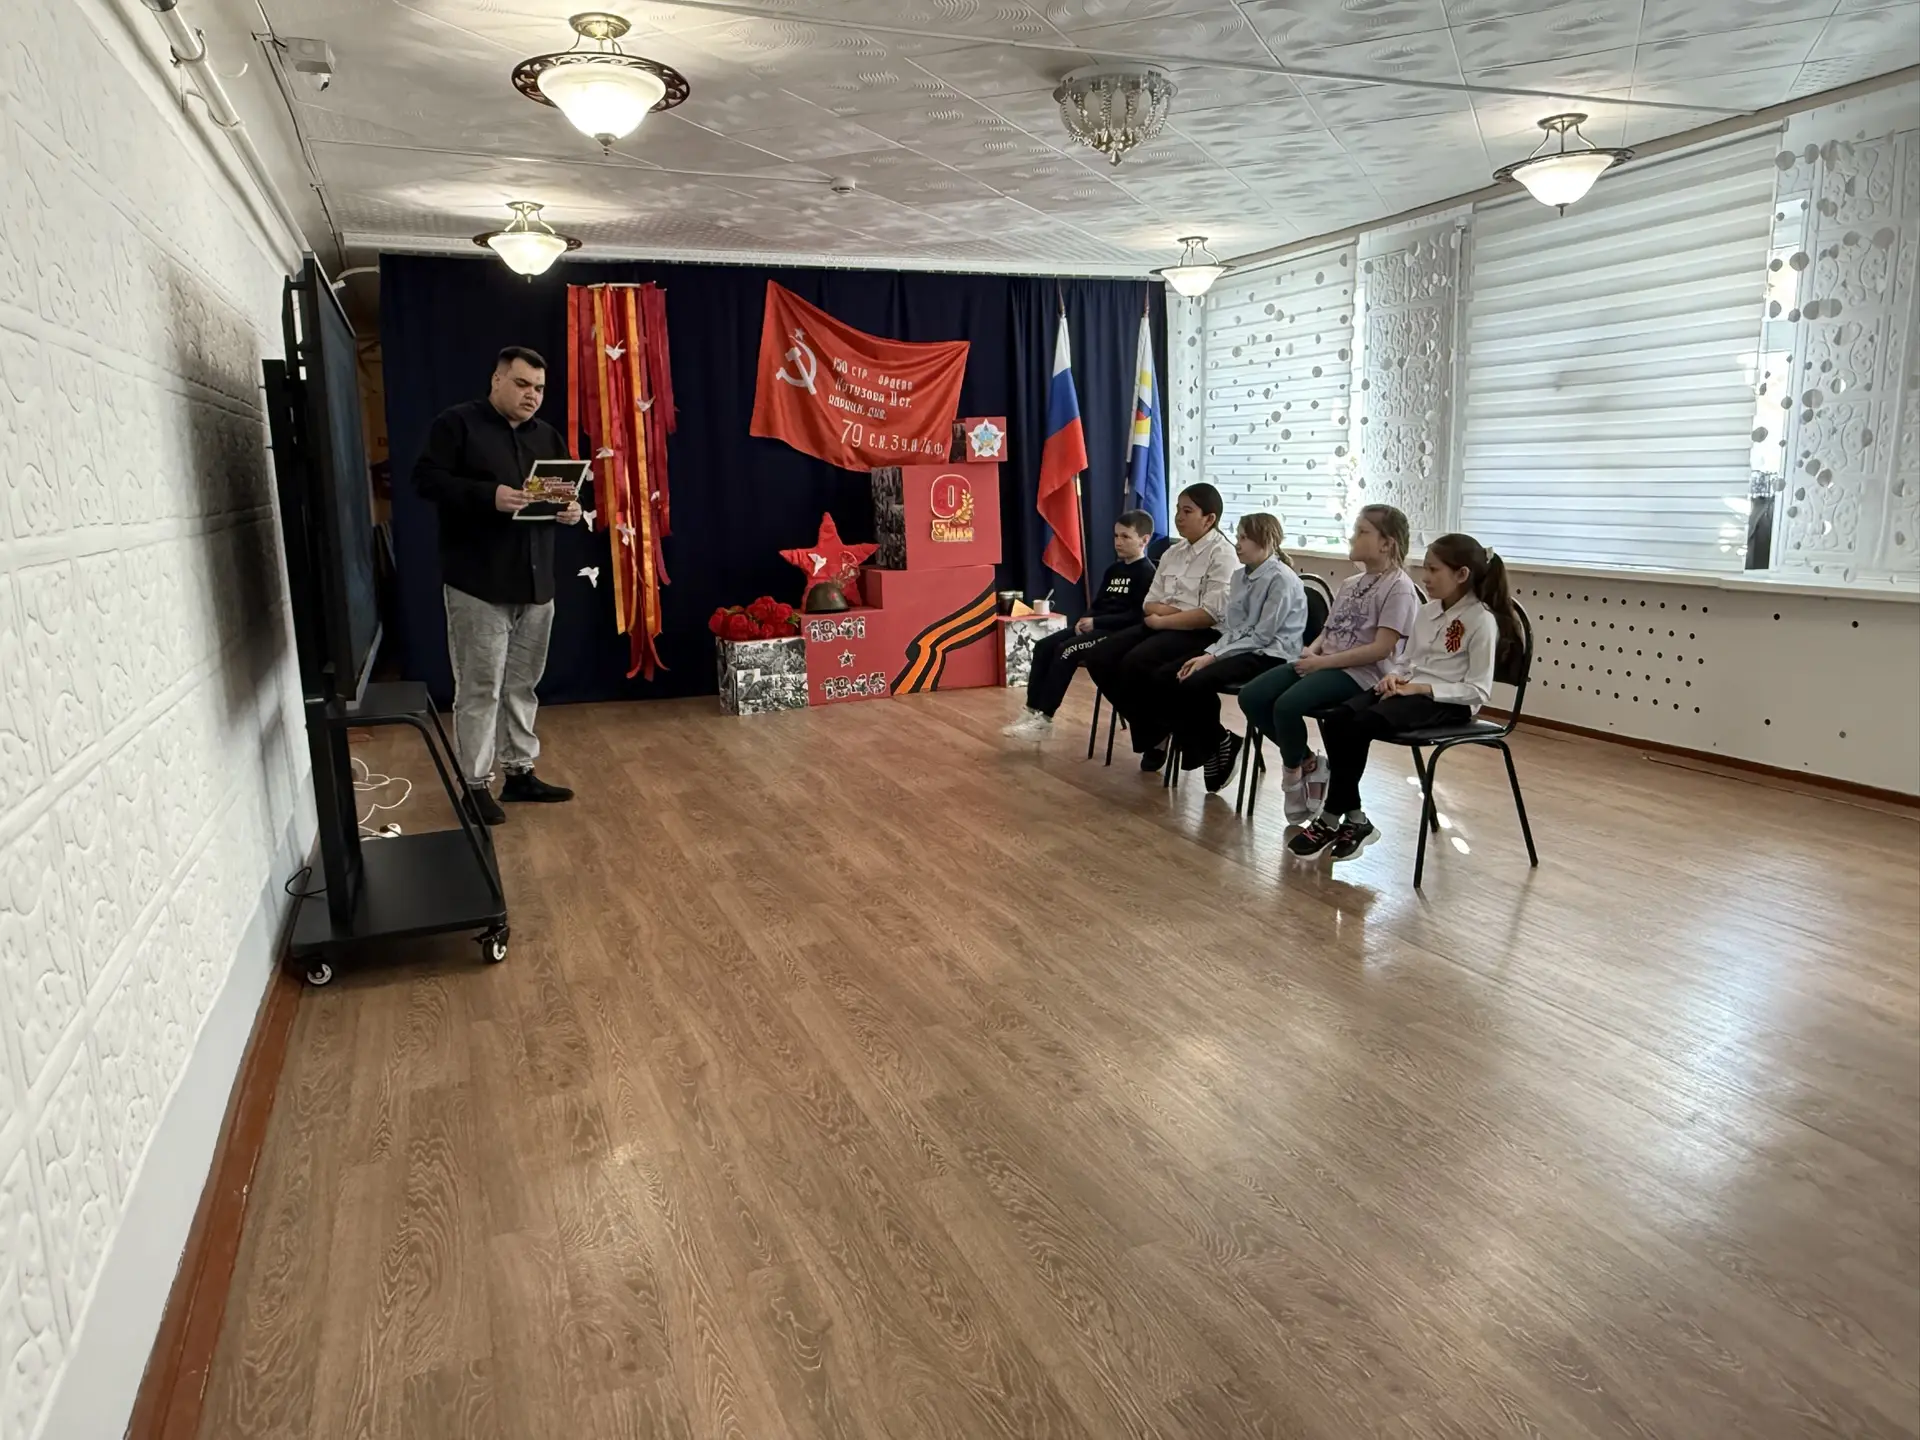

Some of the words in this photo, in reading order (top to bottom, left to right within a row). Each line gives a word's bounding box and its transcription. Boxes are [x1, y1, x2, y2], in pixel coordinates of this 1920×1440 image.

[841, 419, 863, 448] 79
[805, 616, 866, 643] 1941
[820, 672, 886, 699] 1945
